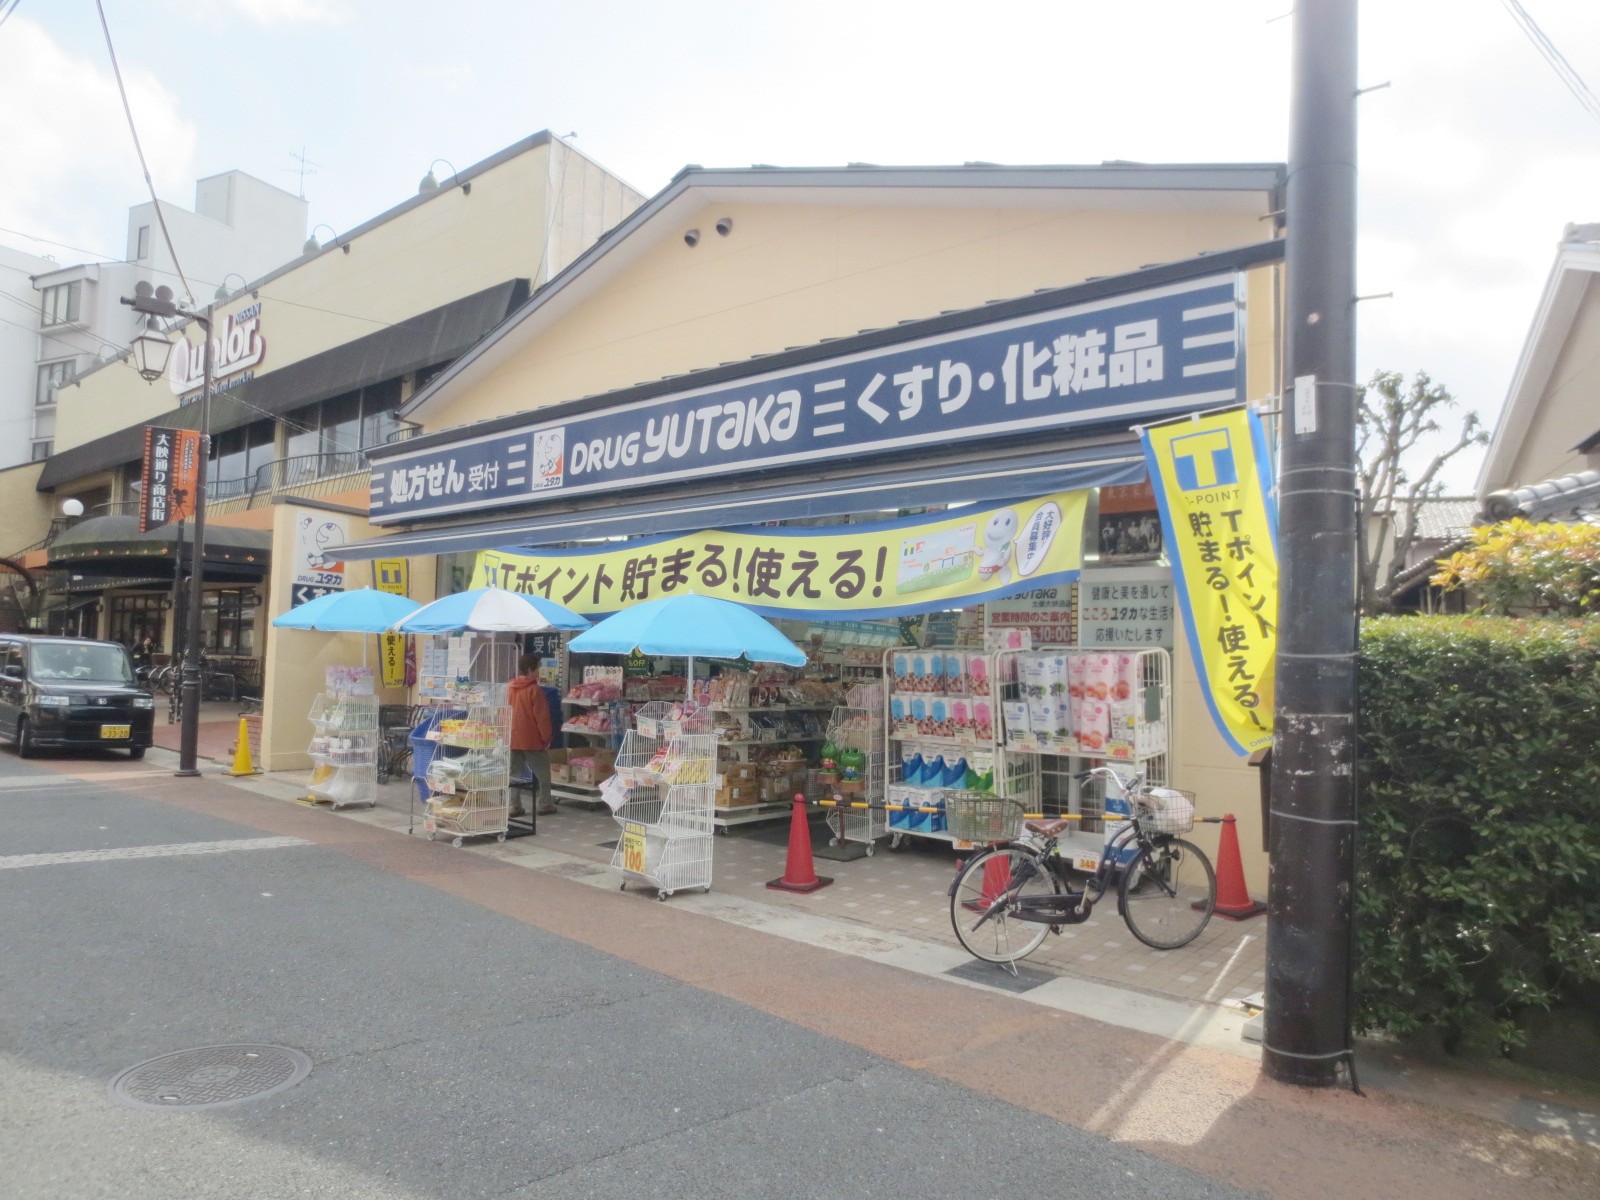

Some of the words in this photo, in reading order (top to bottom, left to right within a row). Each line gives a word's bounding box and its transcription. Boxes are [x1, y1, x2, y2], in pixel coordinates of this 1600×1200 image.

[857, 318, 1164, 425] くすり・化粧品
[570, 431, 641, 476] DRUG
[152, 434, 170, 521] 大映通り商店街
[390, 459, 466, 504] 処方せん
[468, 460, 500, 493] 受付
[315, 573, 342, 585] ユタカ
[1219, 509, 1277, 639] Tポイント
[1091, 584, 1170, 601] 健康と美を通して
[991, 611, 1071, 624] 営業時間のご案内
[1039, 626, 1071, 642] 10:00
[1095, 627, 1164, 642] 応援いたします
[533, 635, 560, 654] 受付
[1079, 859, 1096, 869] 348
